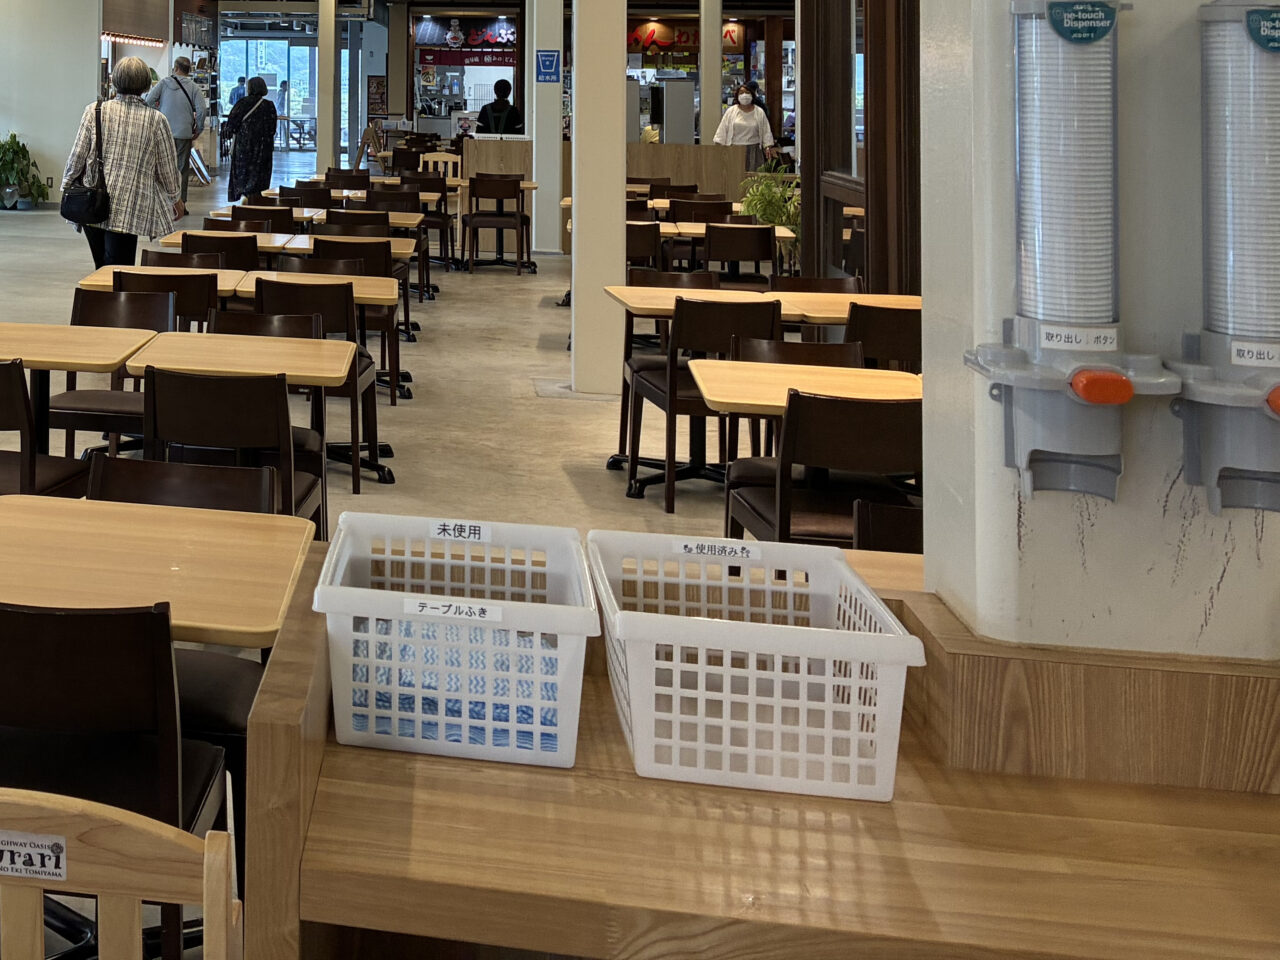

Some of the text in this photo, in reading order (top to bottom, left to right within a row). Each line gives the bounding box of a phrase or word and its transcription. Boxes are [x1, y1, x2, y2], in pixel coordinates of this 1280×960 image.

[1063, 20, 1110, 29] Dispenser
[1045, 331, 1116, 345] 取り出し ボタン
[1236, 348, 1274, 361] 取り出し
[437, 523, 482, 540] 未使用
[695, 542, 739, 558] 使用済み
[417, 602, 488, 619] テーブルふき
